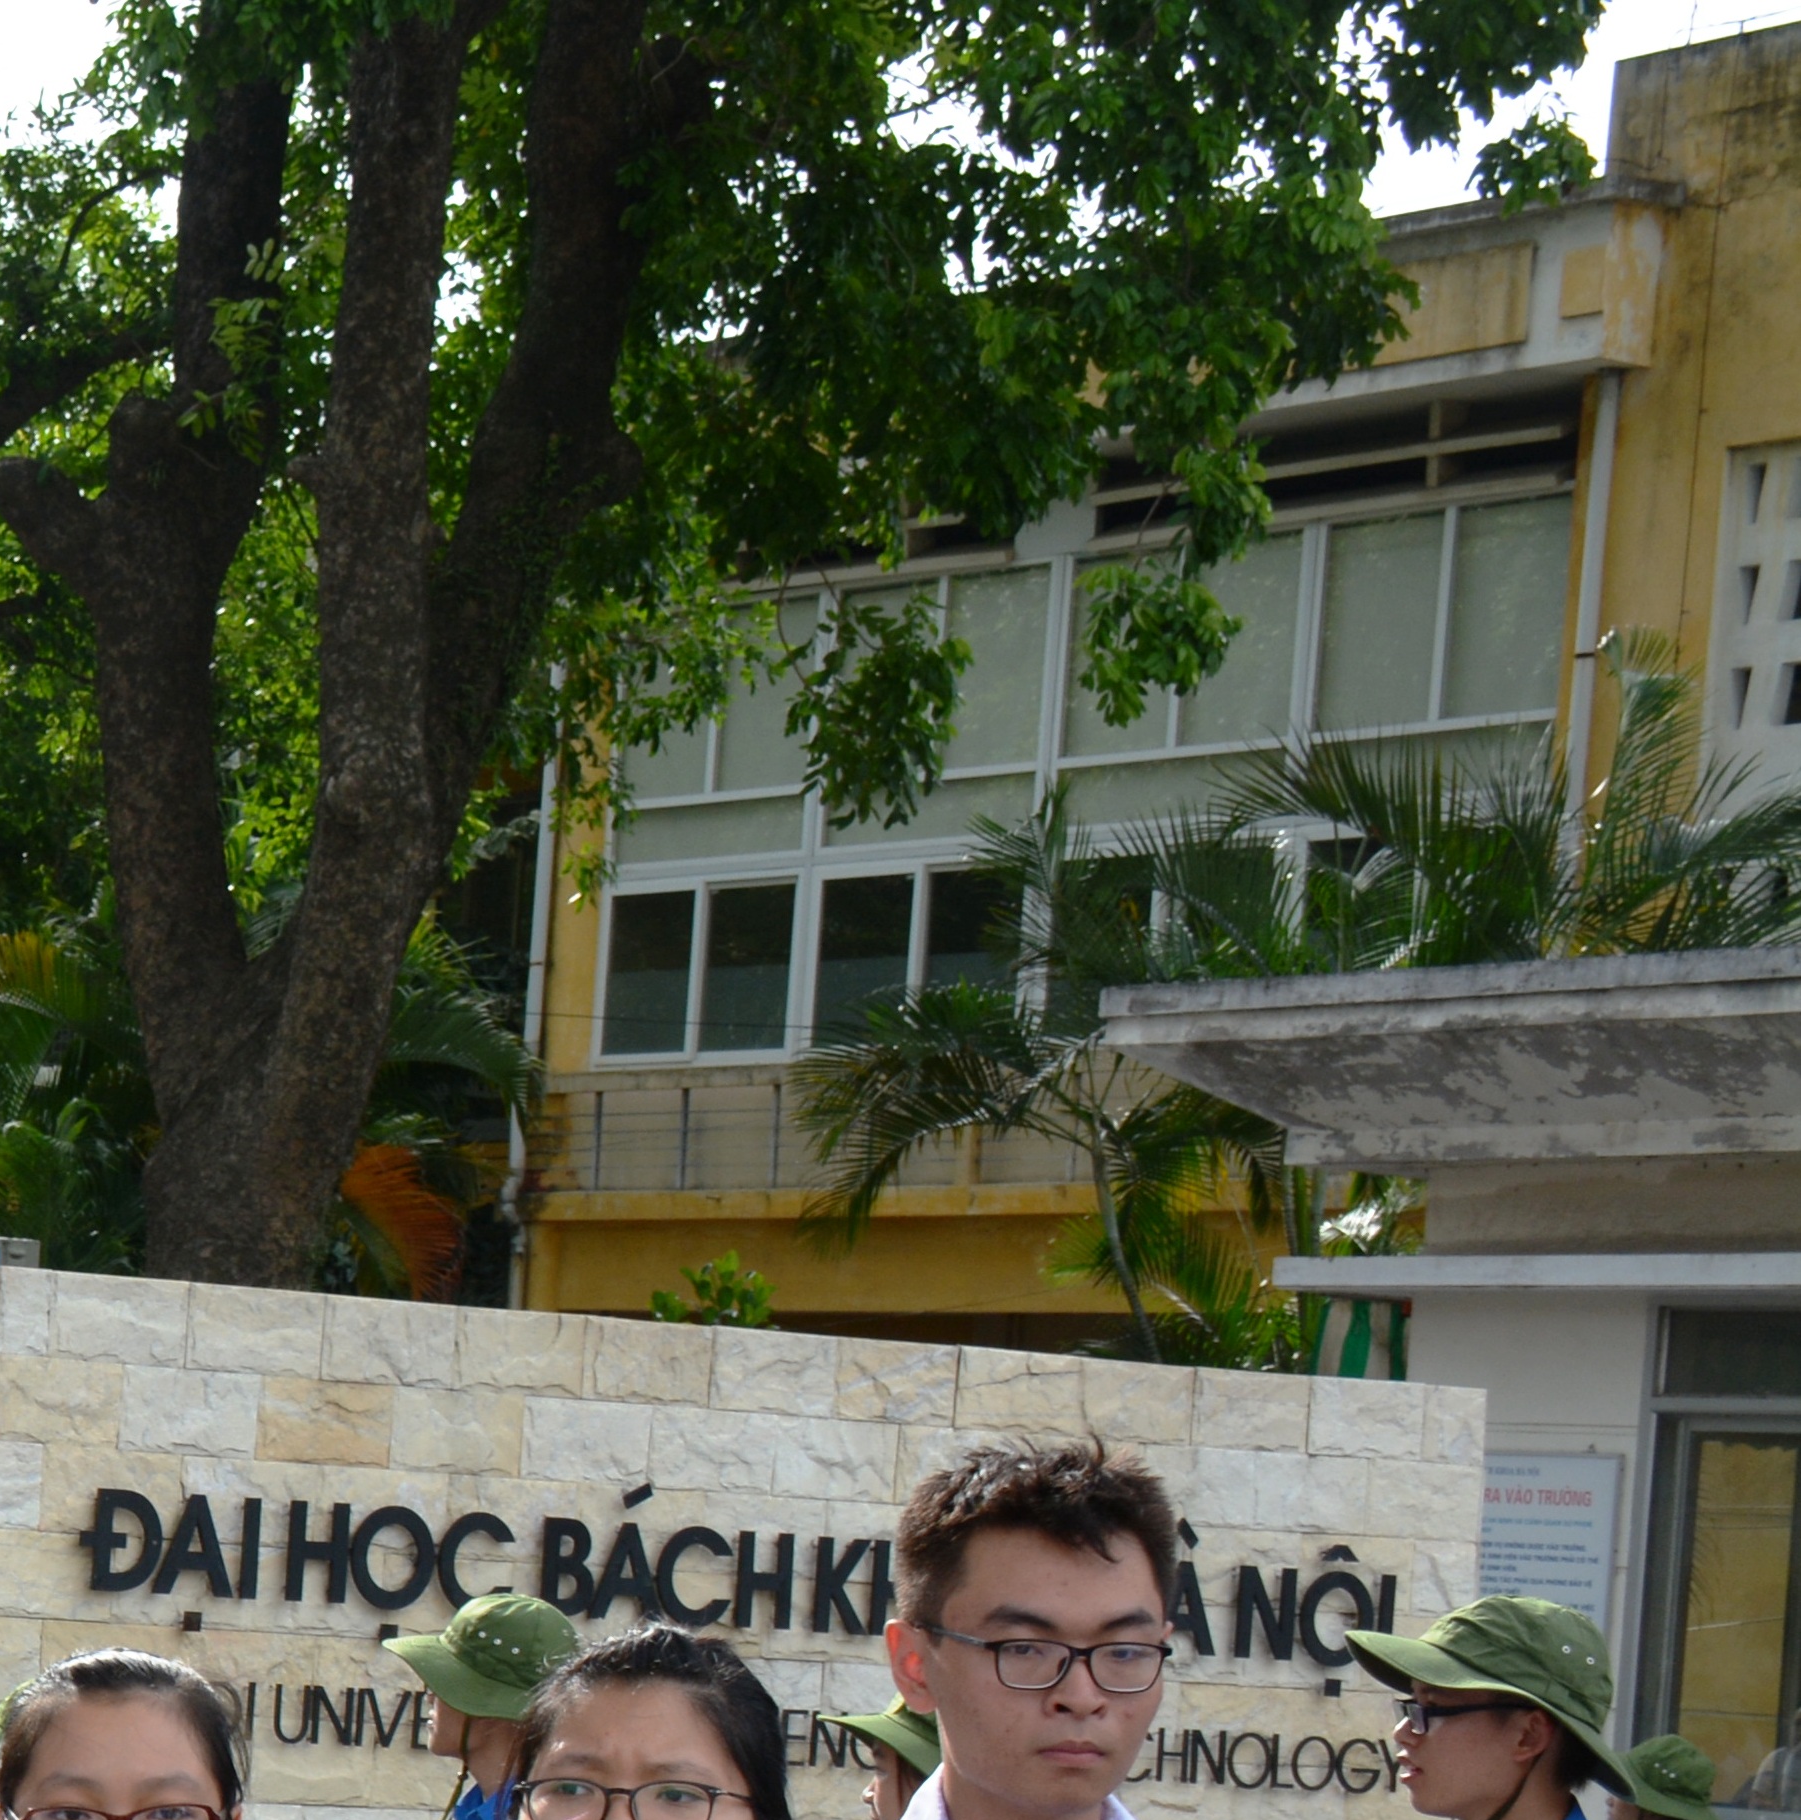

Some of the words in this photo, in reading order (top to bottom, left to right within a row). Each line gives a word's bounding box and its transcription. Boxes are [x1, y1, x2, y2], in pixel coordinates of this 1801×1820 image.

[1483, 1488, 1501, 1504] RA
[1505, 1484, 1533, 1505] VÀO
[1537, 1486, 1593, 1508] TRƯỜNG
[78, 1487, 263, 1632] ĐẠI
[285, 1499, 515, 1640] HỌC
[540, 1482, 795, 1631] BÁCH
[1234, 1543, 1397, 1697] NỘI
